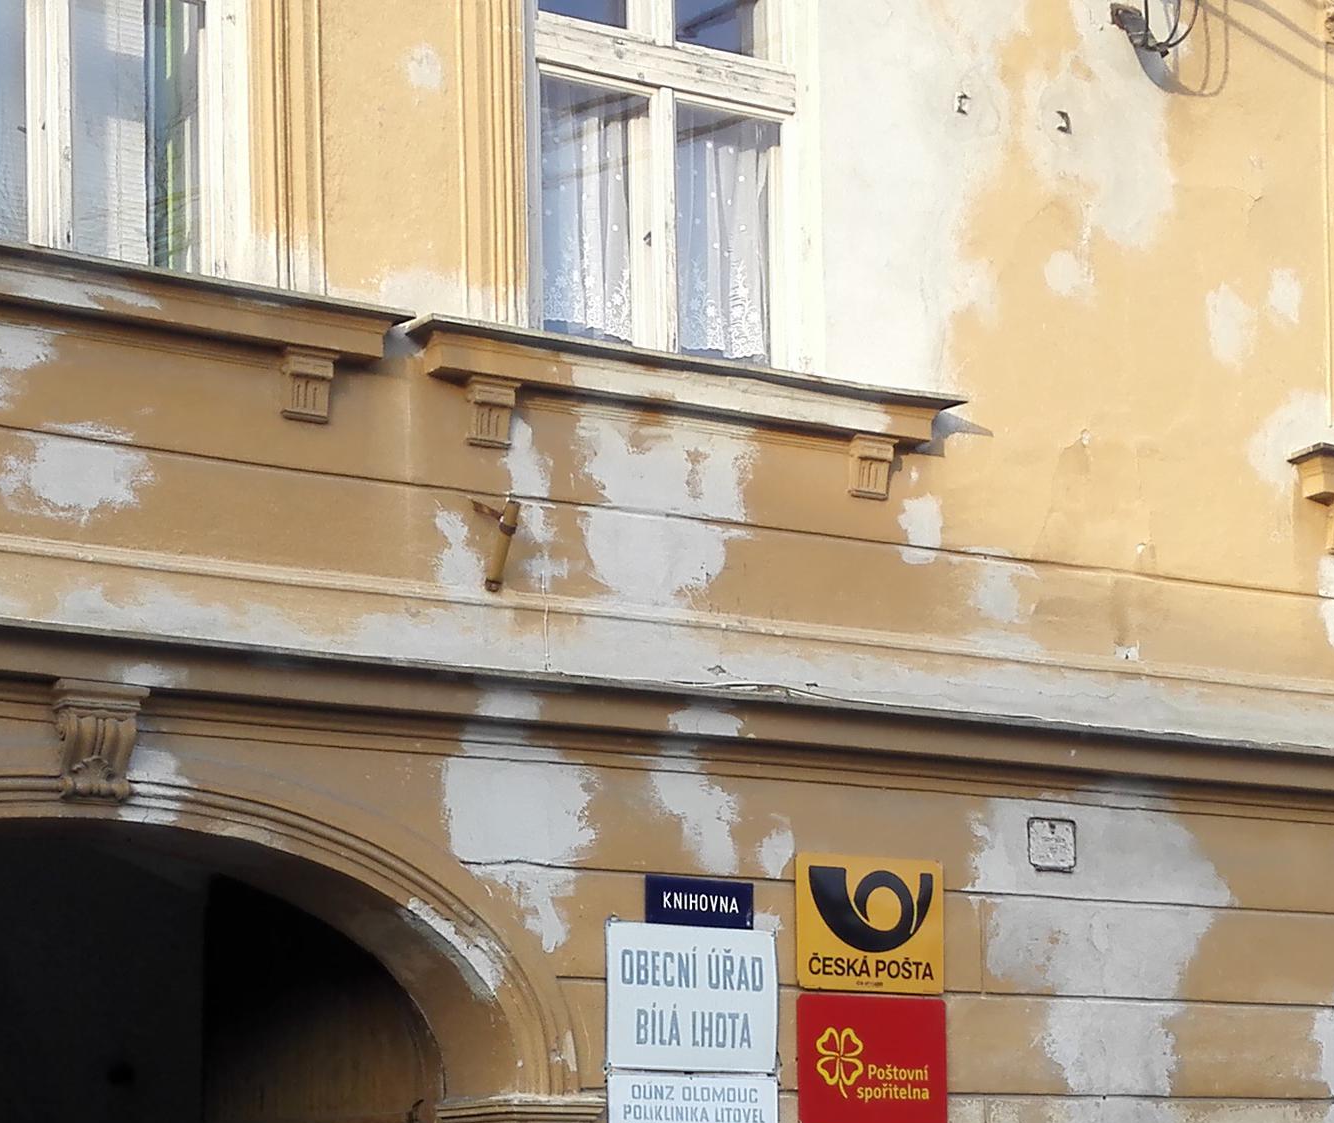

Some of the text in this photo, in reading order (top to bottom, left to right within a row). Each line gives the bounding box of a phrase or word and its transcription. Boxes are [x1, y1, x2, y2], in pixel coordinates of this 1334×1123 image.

[662, 891, 740, 914] KNIHOVNA
[621, 946, 764, 992] OBECNÍ ÚŘAD
[808, 952, 934, 981] ČESKÁ POŠTA
[635, 1002, 752, 1049] BÍLÁ LHOTA
[867, 1063, 930, 1081] Poštovní
[681, 1085, 759, 1104] OLOMOUC
[856, 1083, 930, 1104] spořitelna
[623, 1104, 766, 1123] POLIKLINIKA LITOVEL
